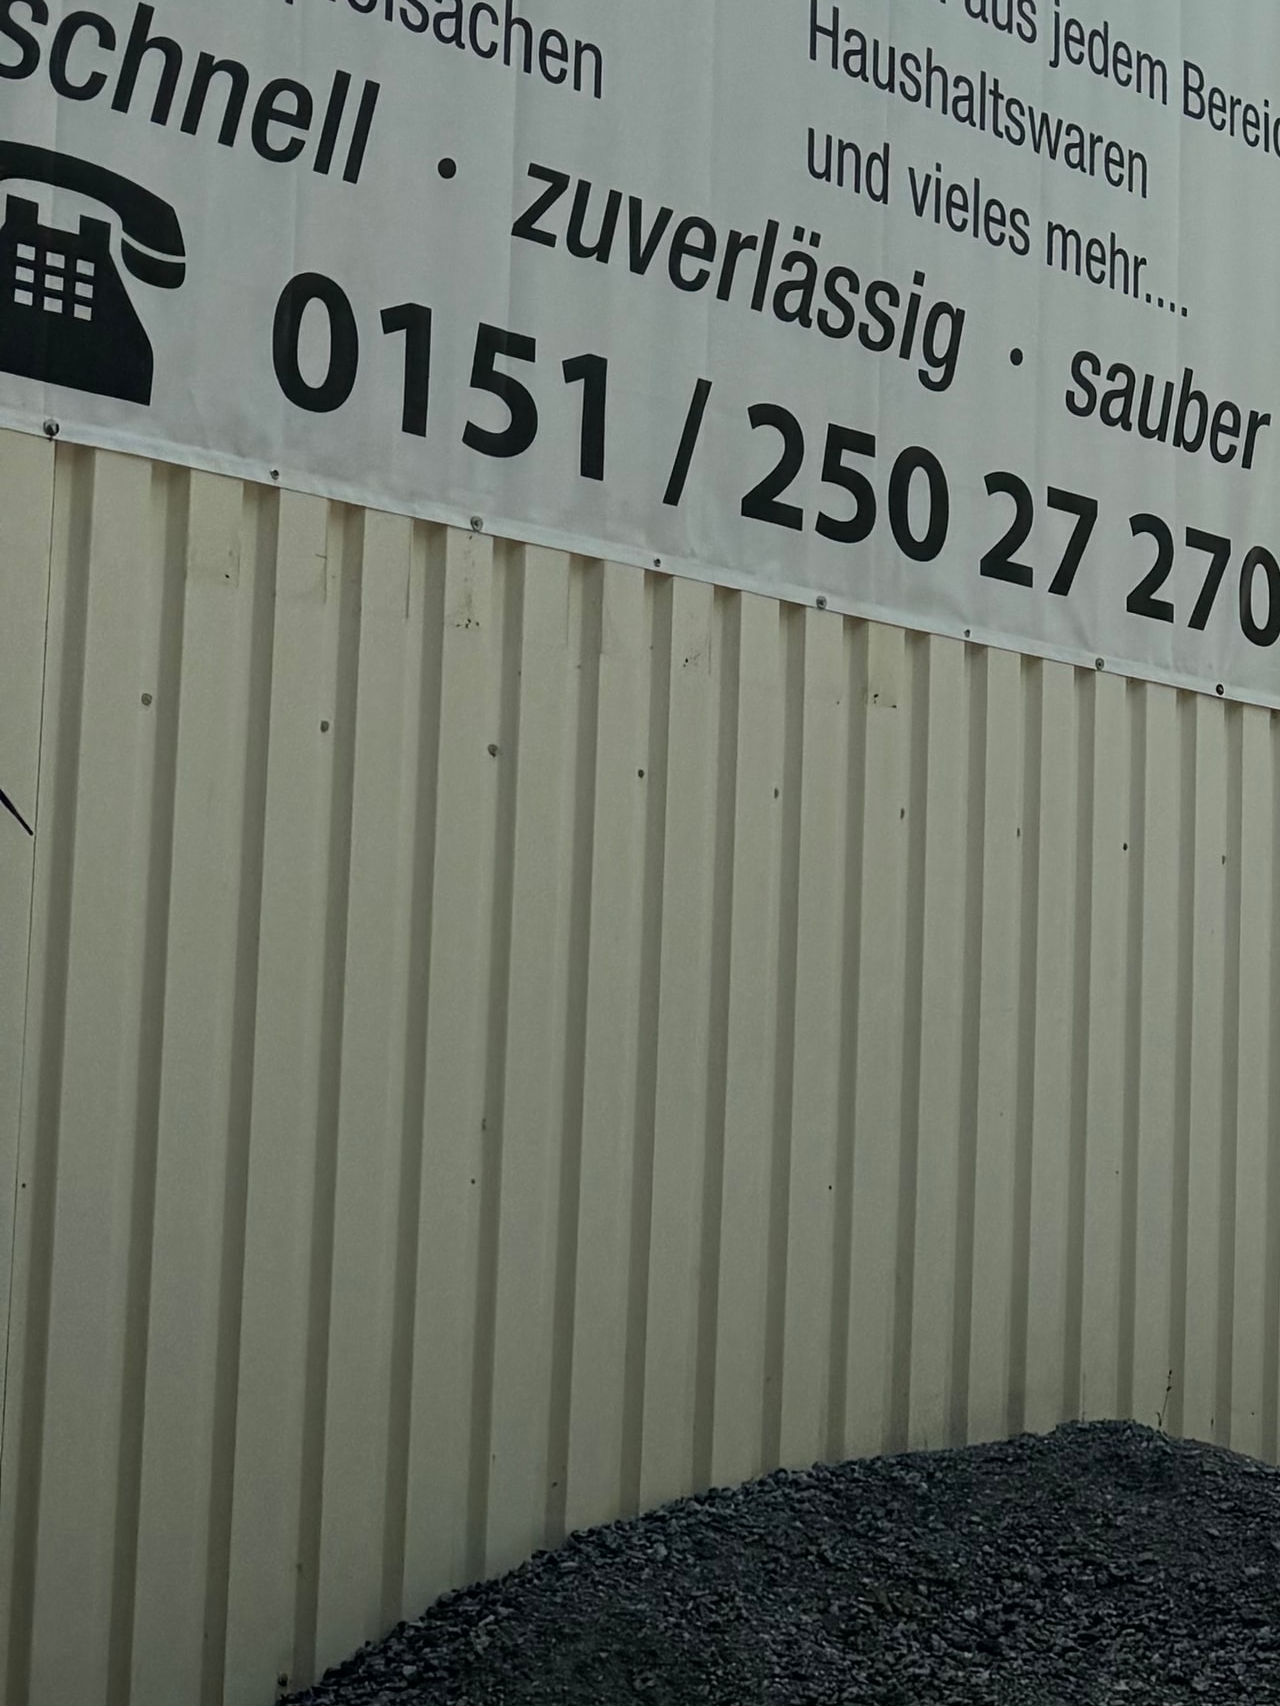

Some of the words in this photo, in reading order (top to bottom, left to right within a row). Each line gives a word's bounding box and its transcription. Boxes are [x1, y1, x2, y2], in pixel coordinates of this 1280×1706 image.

[1049, 11, 1167, 105] jedem
[808, 127, 890, 205] und
[908, 167, 1030, 256] vieles
[511, 163, 965, 392] zuverlässig
[1065, 351, 1271, 470] sauber
[272, 272, 608, 481] 0151
[662, 378, 712, 507] /
[741, 403, 949, 562] 250
[980, 471, 1098, 597] 27
